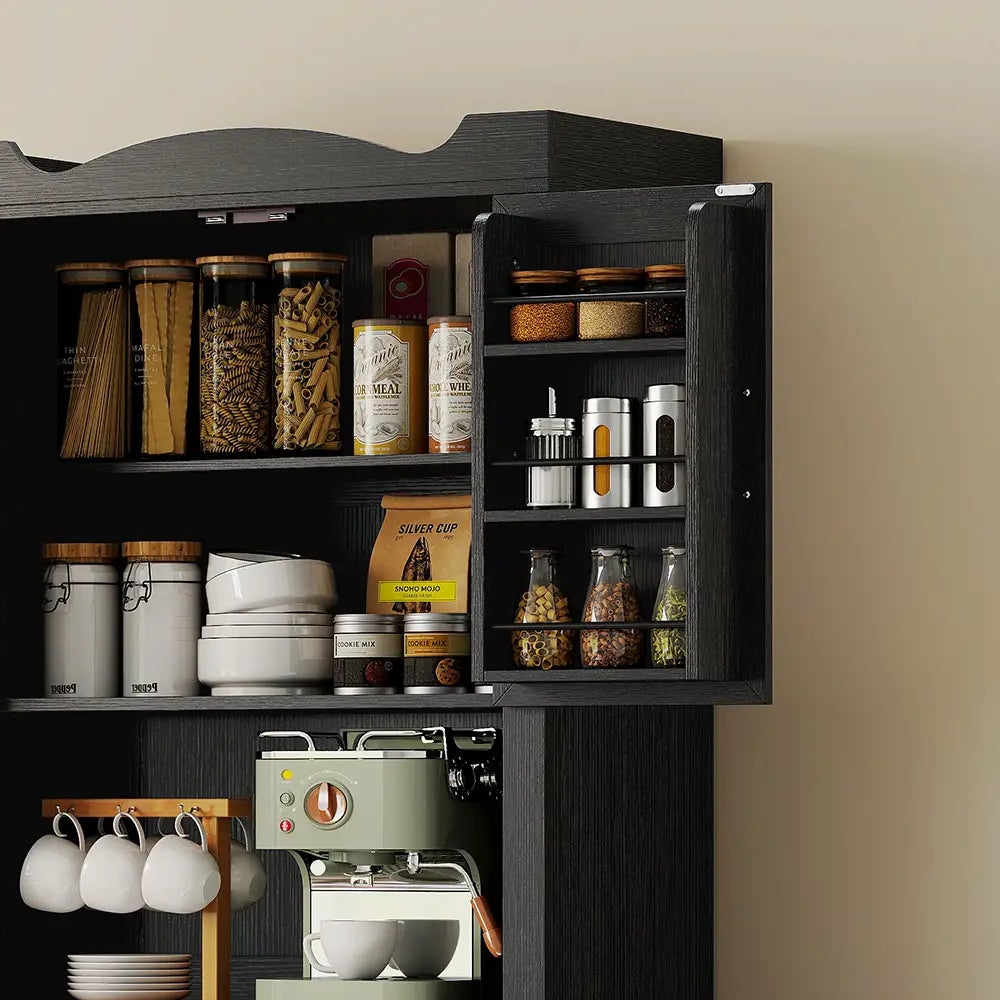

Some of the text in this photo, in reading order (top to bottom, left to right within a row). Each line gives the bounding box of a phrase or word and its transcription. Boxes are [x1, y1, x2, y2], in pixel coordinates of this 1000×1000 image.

[355, 383, 402, 395] CORMEAL
[398, 523, 458, 534] SILVER CUP
[420, 585, 441, 593] MOJO
[361, 640, 376, 648] MIX
